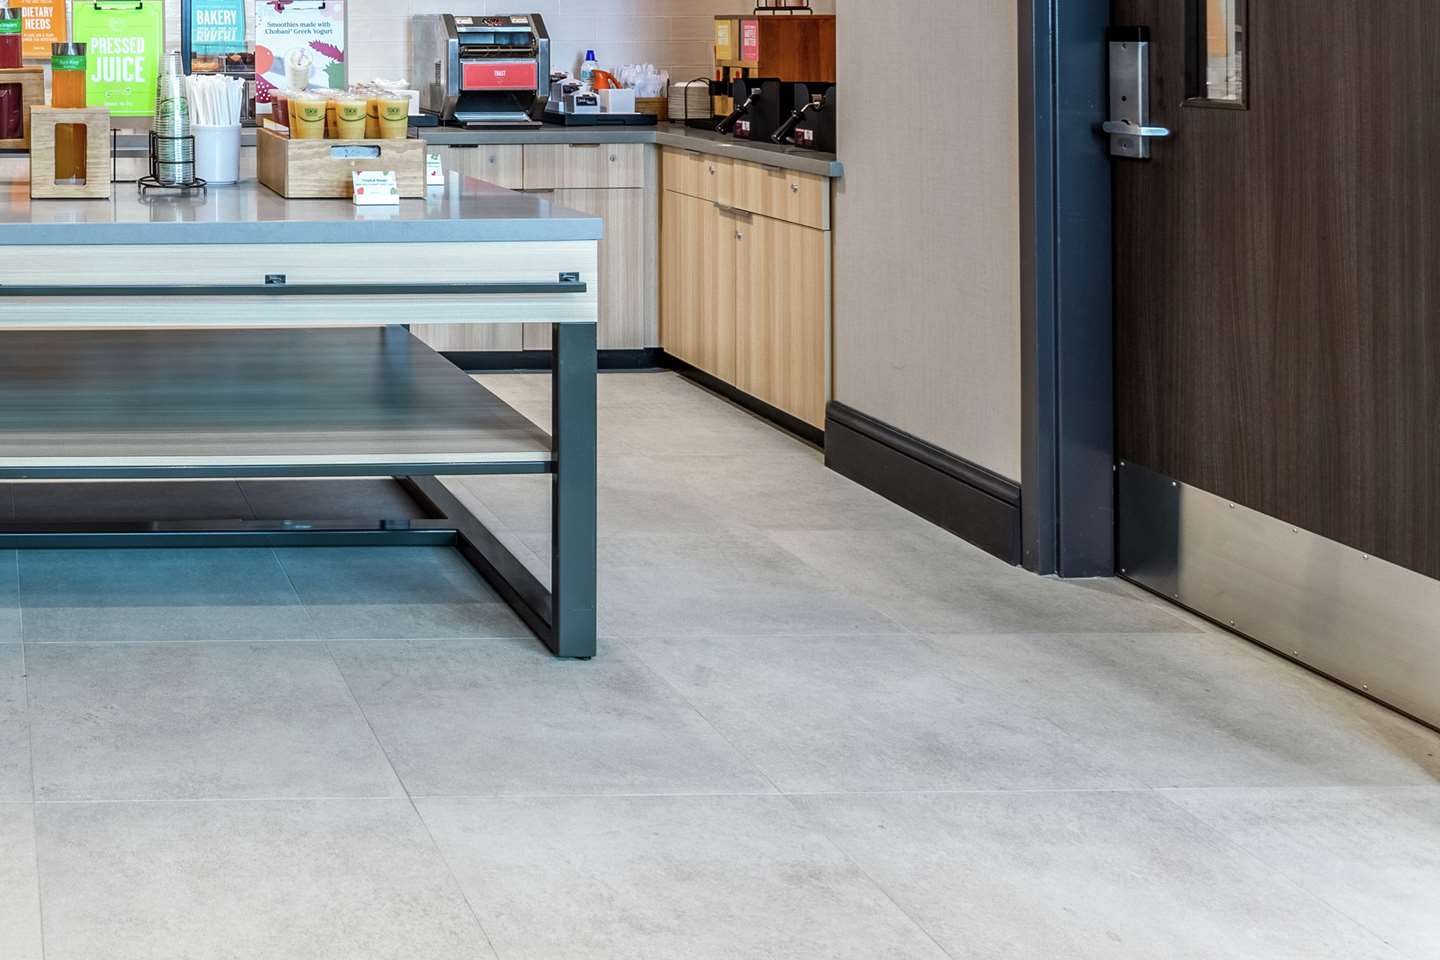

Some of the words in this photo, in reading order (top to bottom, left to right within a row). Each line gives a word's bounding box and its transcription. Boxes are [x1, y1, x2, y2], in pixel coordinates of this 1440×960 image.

[22, 6, 54, 17] DIETARY
[196, 9, 237, 25] BAKERY
[25, 19, 51, 30] NEEDS
[90, 37, 145, 54] PRESSED
[91, 56, 145, 83] JUICE
